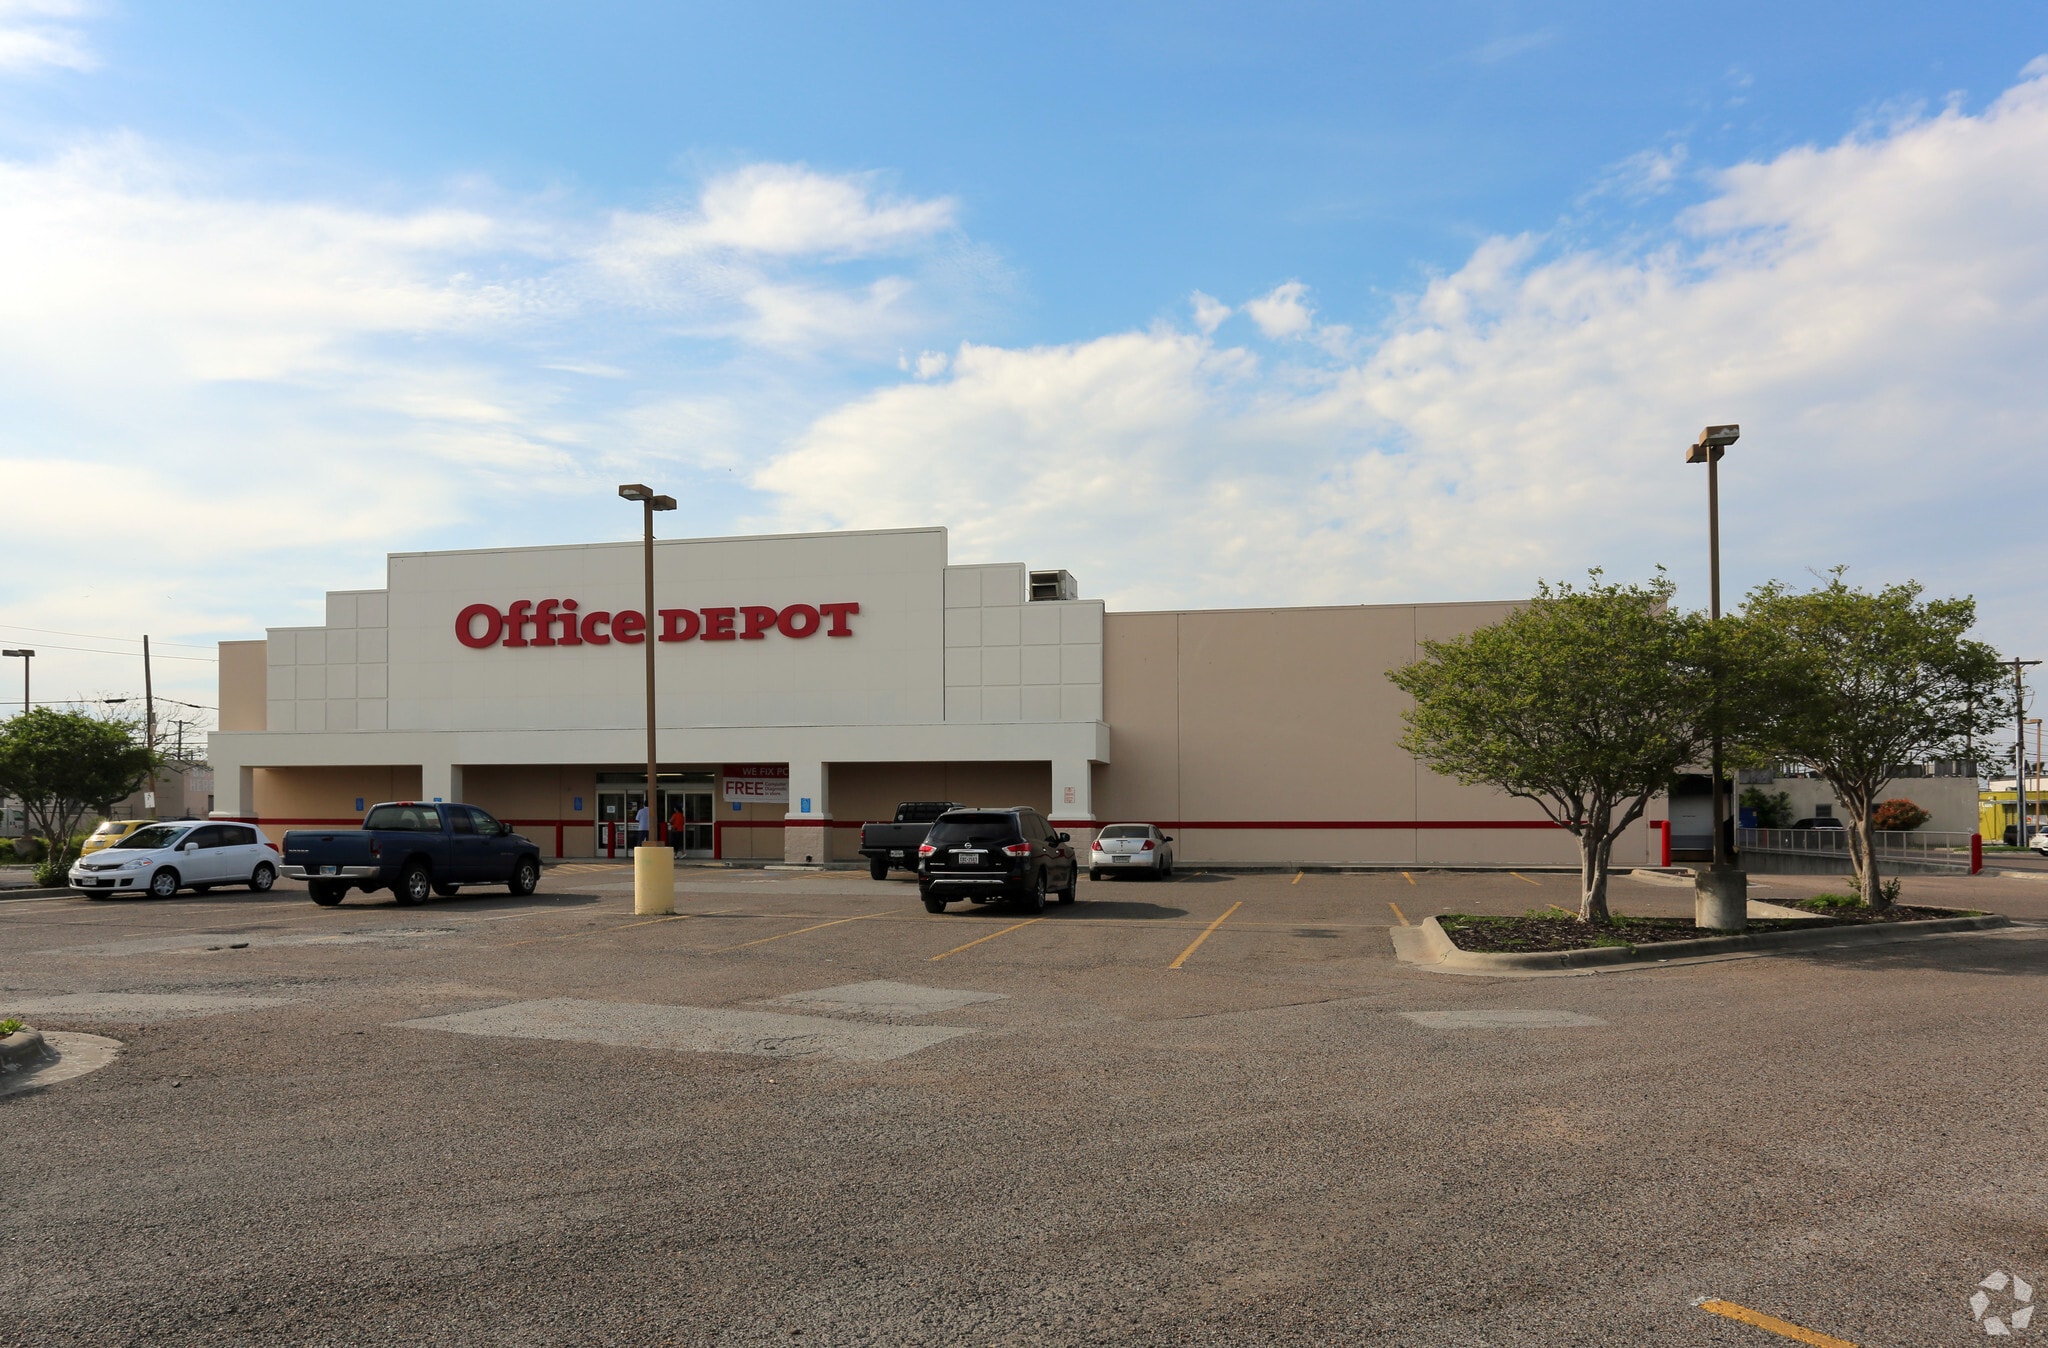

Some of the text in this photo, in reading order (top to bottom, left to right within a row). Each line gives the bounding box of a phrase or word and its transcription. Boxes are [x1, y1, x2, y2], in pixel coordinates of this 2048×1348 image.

[455, 598, 860, 649] Office DEPOT
[743, 767, 757, 775] WE
[760, 767, 774, 775] FIX
[726, 781, 764, 796] FREE
